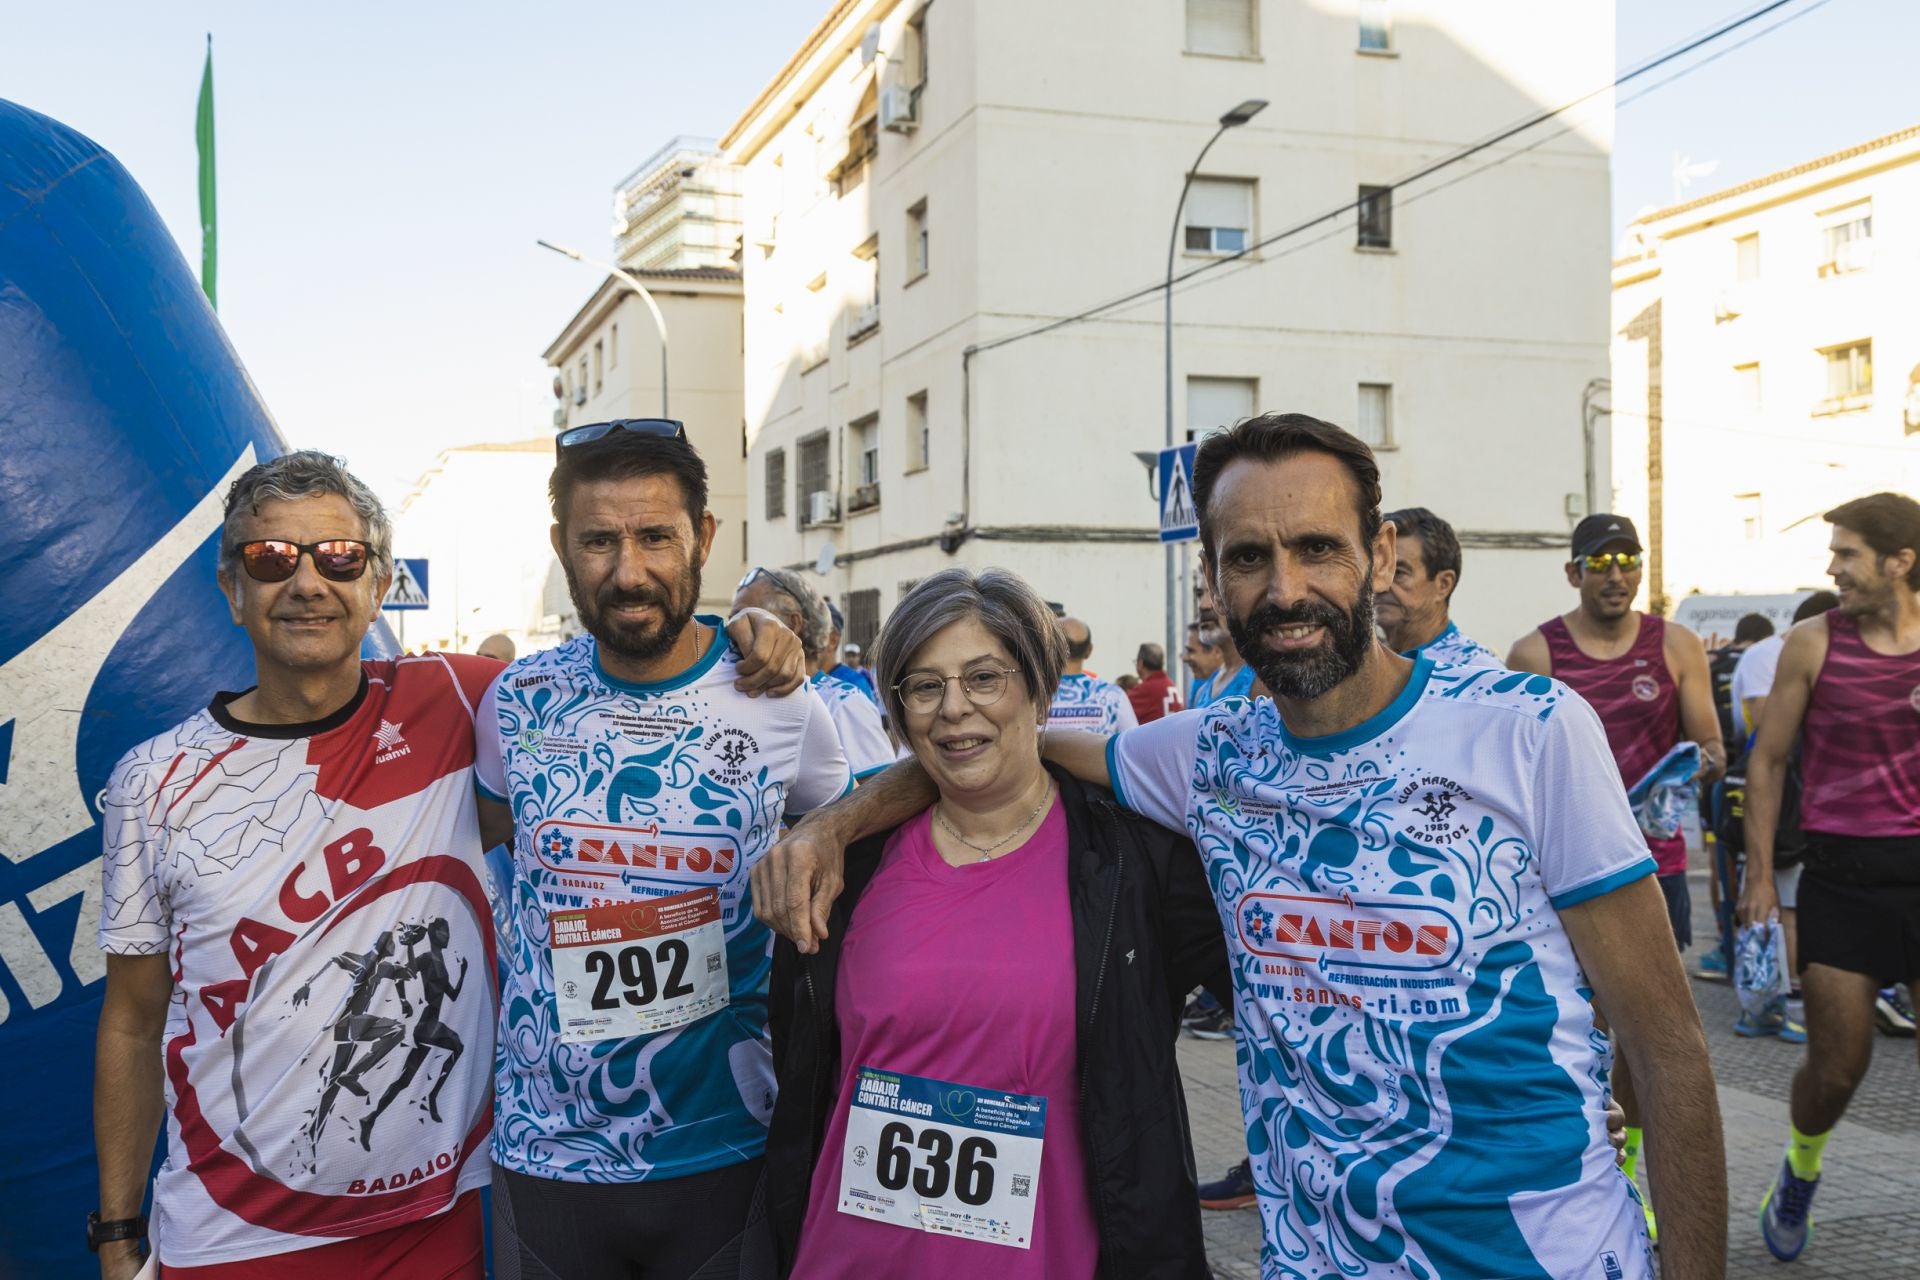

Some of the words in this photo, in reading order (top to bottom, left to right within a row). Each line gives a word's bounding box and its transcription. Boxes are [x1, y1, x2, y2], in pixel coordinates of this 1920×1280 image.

[704, 732, 722, 751] CLUB
[723, 728, 760, 754] MARATON
[375, 744, 411, 765] luanvi
[708, 769, 754, 786] BADAJOZ
[1397, 781, 1419, 804] CLUB
[1405, 824, 1470, 845] BADAJOZ
[1425, 823, 1450, 832] 1989
[578, 838, 735, 874] SANTOS
[562, 878, 605, 890] BADAJOZ
[199, 827, 386, 1038] AACB
[554, 919, 588, 933] BADAJOZ
[1275, 914, 1448, 956] SANTOS
[555, 932, 583, 945] CONTRA
[582, 931, 591, 942] EL
[591, 928, 622, 942] CÁNCER
[585, 939, 694, 1010] 292
[1265, 964, 1306, 977] BADAJOZ
[1328, 972, 1398, 989] REFRIGERACIÓN
[1400, 977, 1455, 990] INDUSTRIAL
[860, 1077, 900, 1097] BADAJOZ
[858, 1091, 890, 1109] CONTRA
[890, 1097, 899, 1110] EL
[900, 1098, 933, 1117] CÁNCER
[980, 1107, 1005, 1116] beneficio
[975, 1112, 1005, 1122] Asociación
[1005, 1117, 1031, 1126] Española
[999, 1122, 1019, 1130] Cáncer
[346, 1142, 460, 1194] BADAJOZ
[876, 1121, 997, 1206] 636
